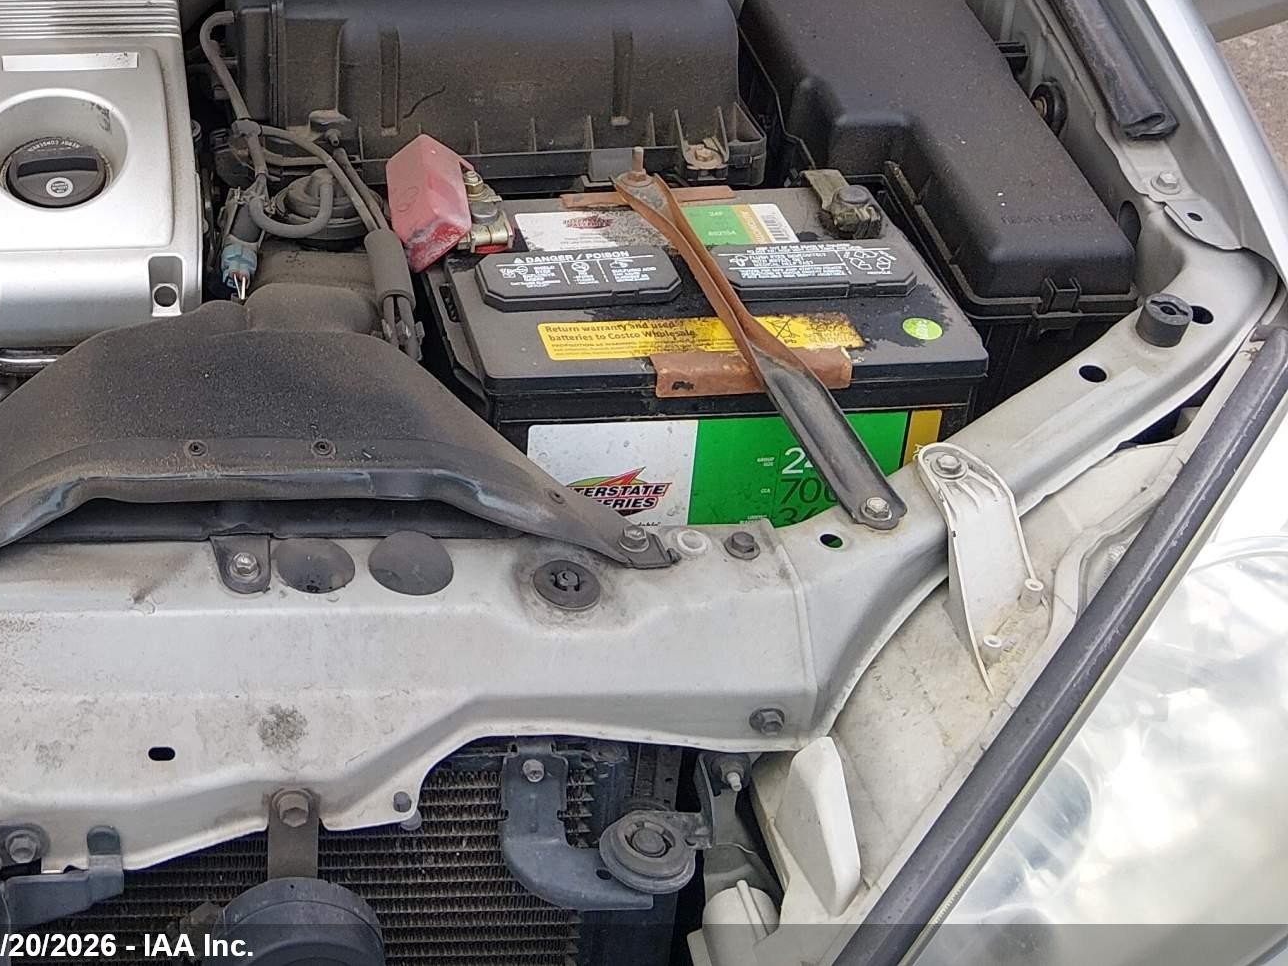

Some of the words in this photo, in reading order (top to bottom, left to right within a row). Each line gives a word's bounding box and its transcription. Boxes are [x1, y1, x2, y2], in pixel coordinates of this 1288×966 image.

[525, 253, 574, 264] DANGER
[585, 250, 630, 260] POISON
[545, 325, 580, 333] Return
[581, 324, 627, 334] warranty
[630, 321, 648, 330] and
[651, 320, 674, 329] used
[548, 333, 593, 342] batteries
[607, 332, 641, 340] Costco
[641, 329, 696, 340] Wholesale
[781, 446, 814, 475] 2
[570, 484, 666, 499] TERSTATE
[597, 496, 657, 509] ERIES
